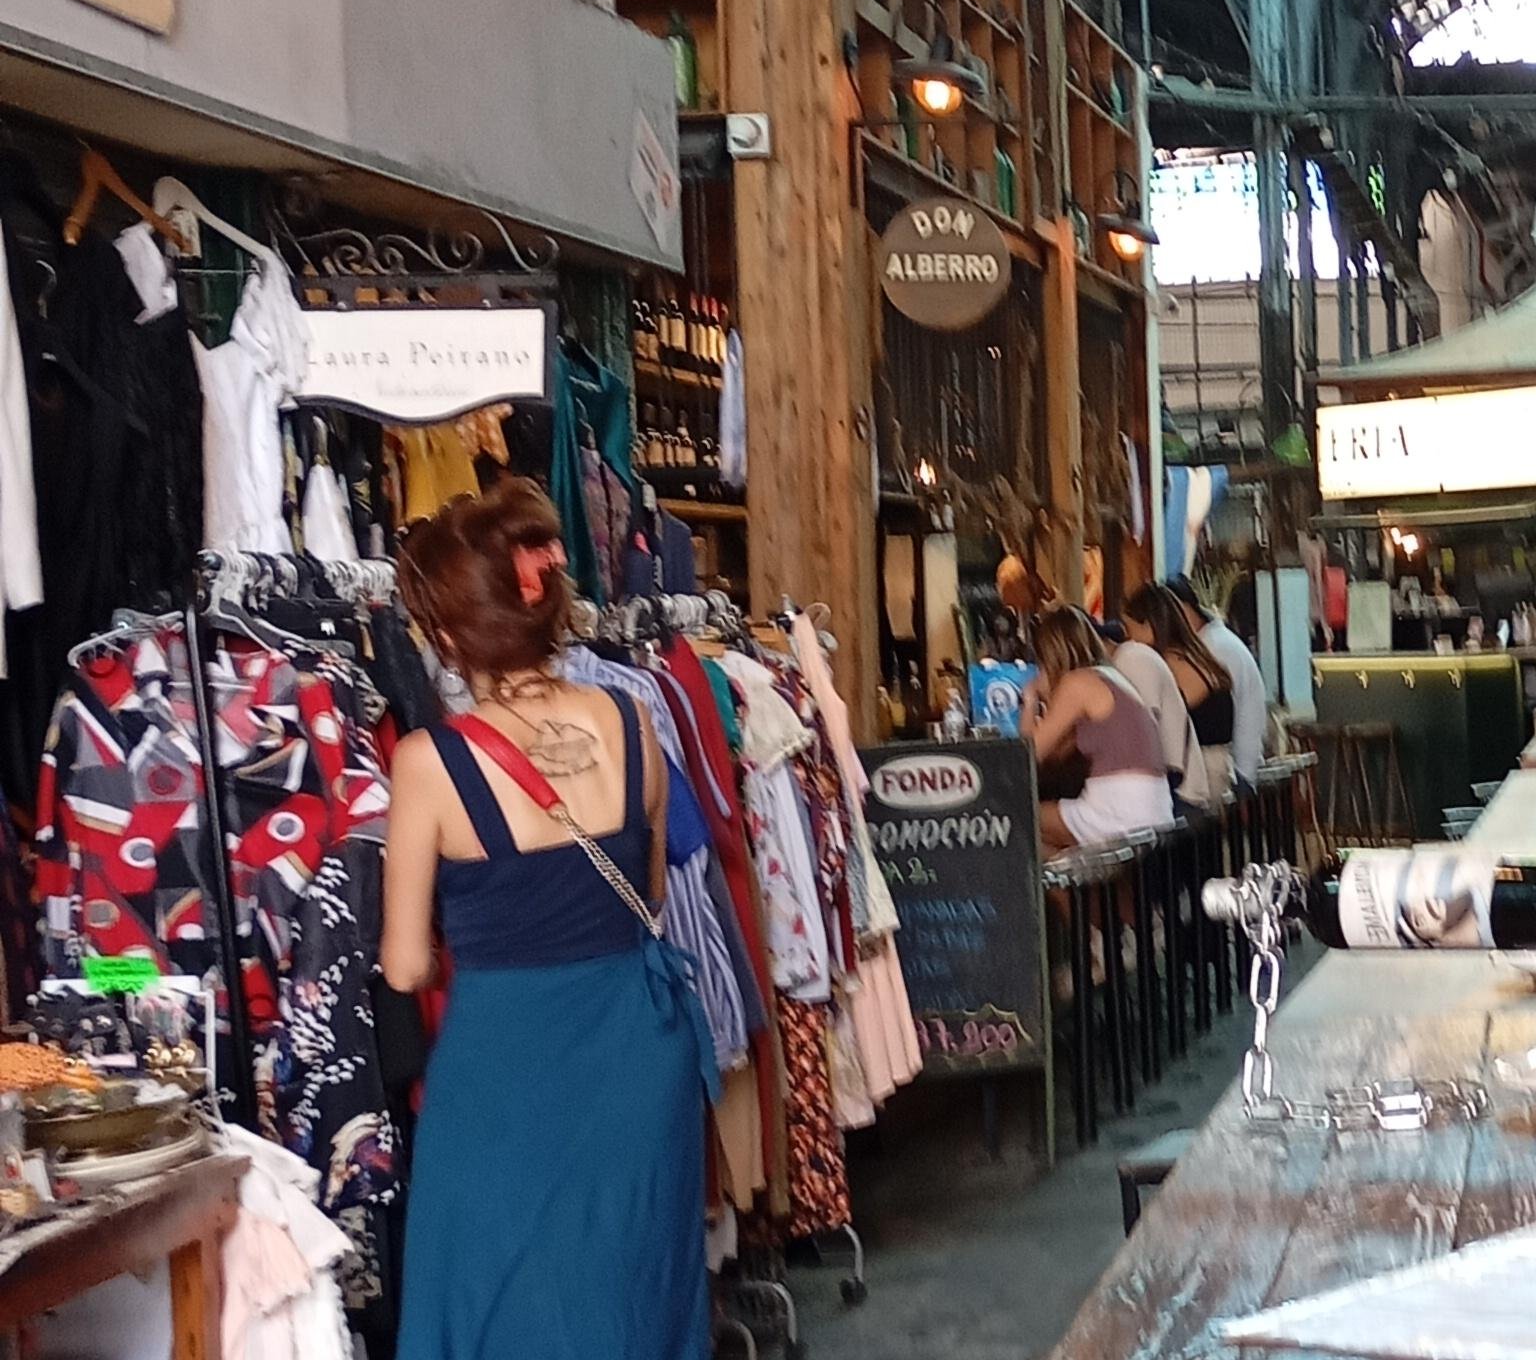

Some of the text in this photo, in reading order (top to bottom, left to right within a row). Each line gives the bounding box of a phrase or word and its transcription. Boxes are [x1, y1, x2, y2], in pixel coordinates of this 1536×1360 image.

[911, 206, 976, 240] DON
[886, 252, 999, 283] ALBERRO
[880, 765, 976, 796] FONDA
